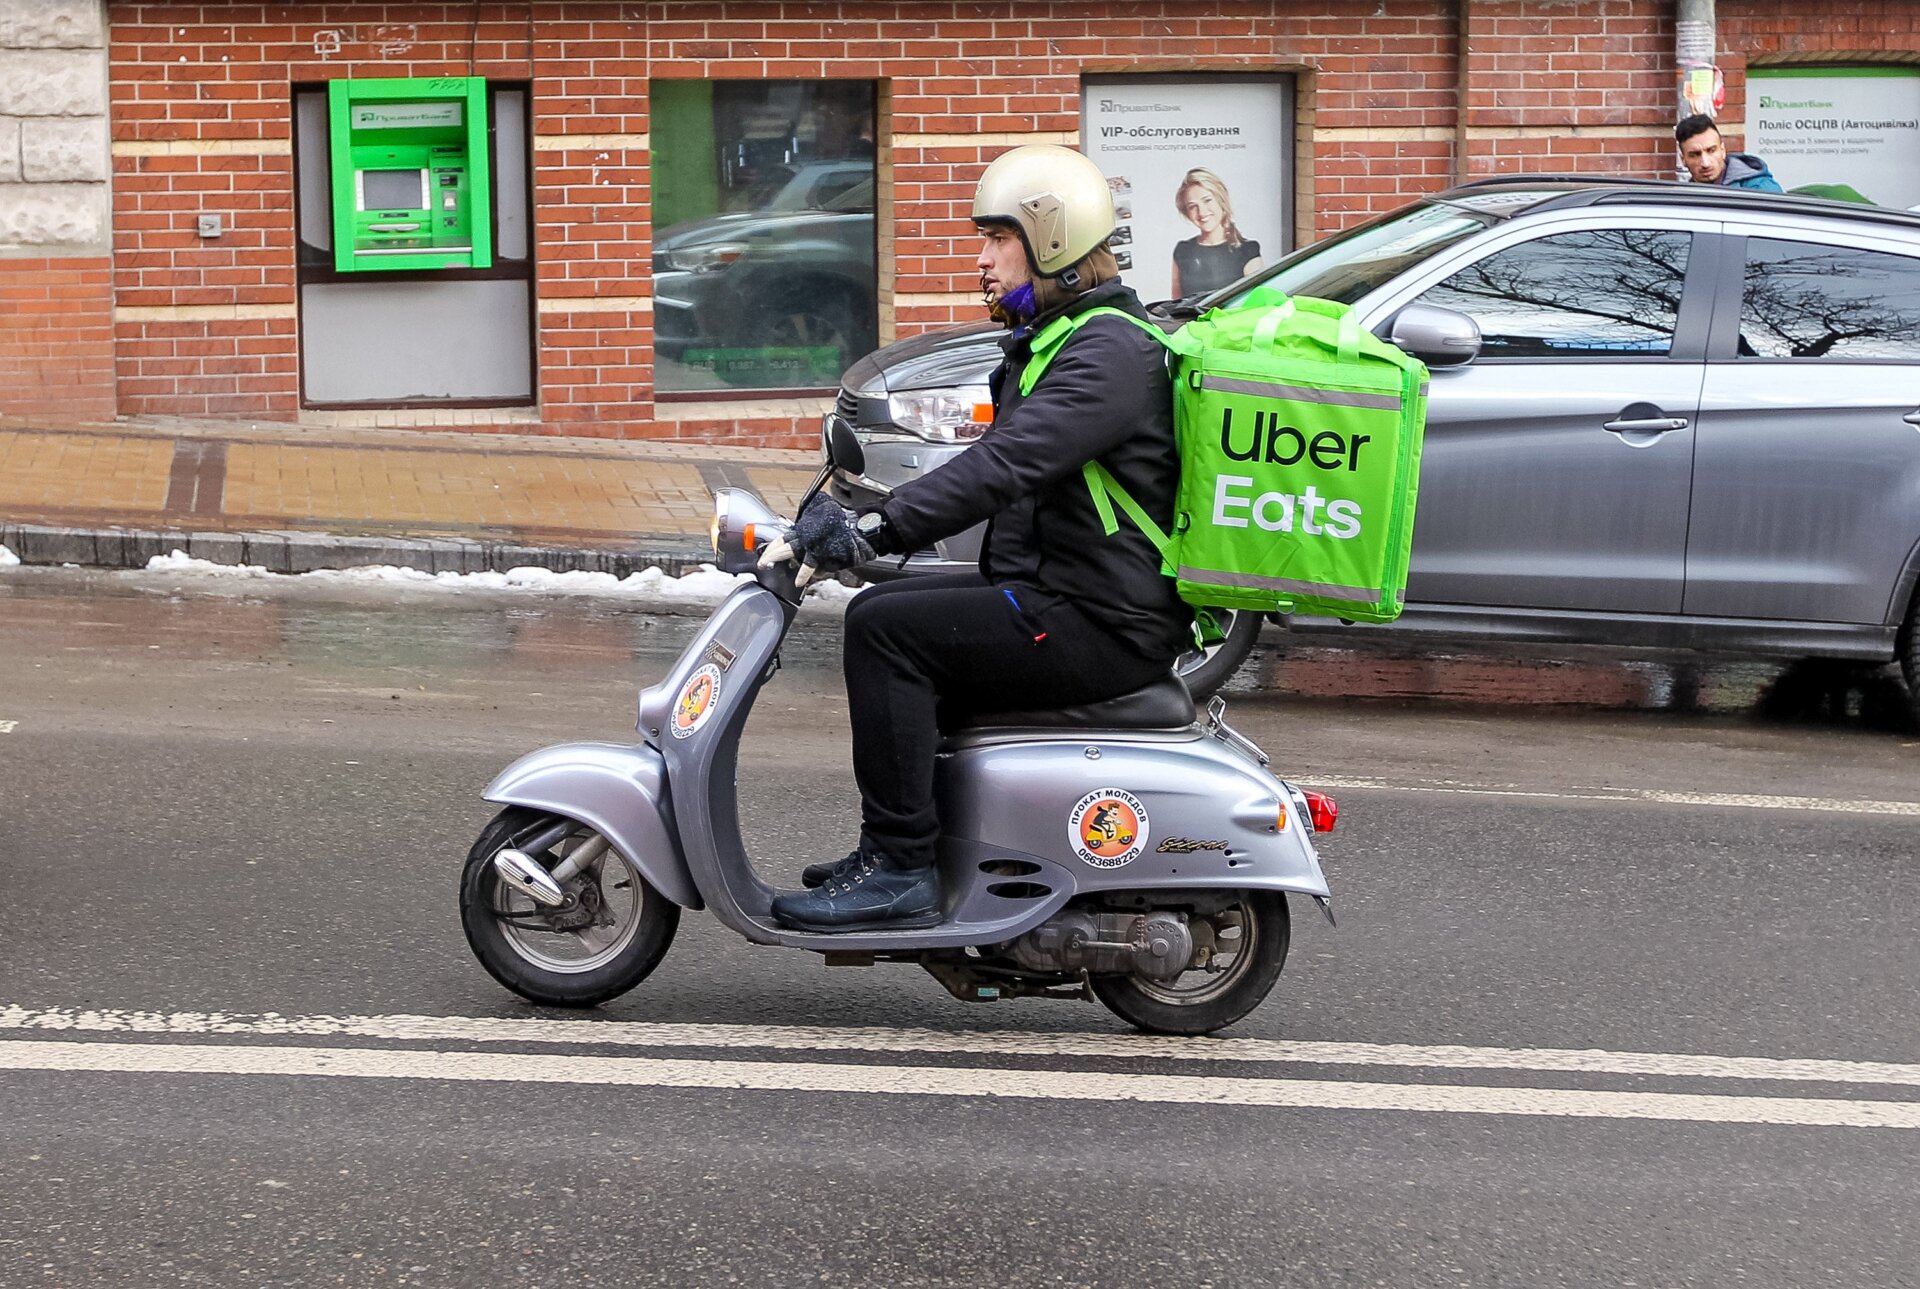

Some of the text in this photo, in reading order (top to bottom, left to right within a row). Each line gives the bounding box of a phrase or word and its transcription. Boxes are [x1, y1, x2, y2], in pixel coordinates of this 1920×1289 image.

[1101, 126, 1241, 139] VIP-обслуговування
[1759, 118, 1919, 131] Поліс ОСЦПВ (Автоцивілка)
[1220, 408, 1371, 471] Uber
[1211, 474, 1362, 539] Eats
[1071, 790, 1147, 825] ПРОКАТ МОПЕДОВ
[1078, 847, 1140, 867] 0663688229
